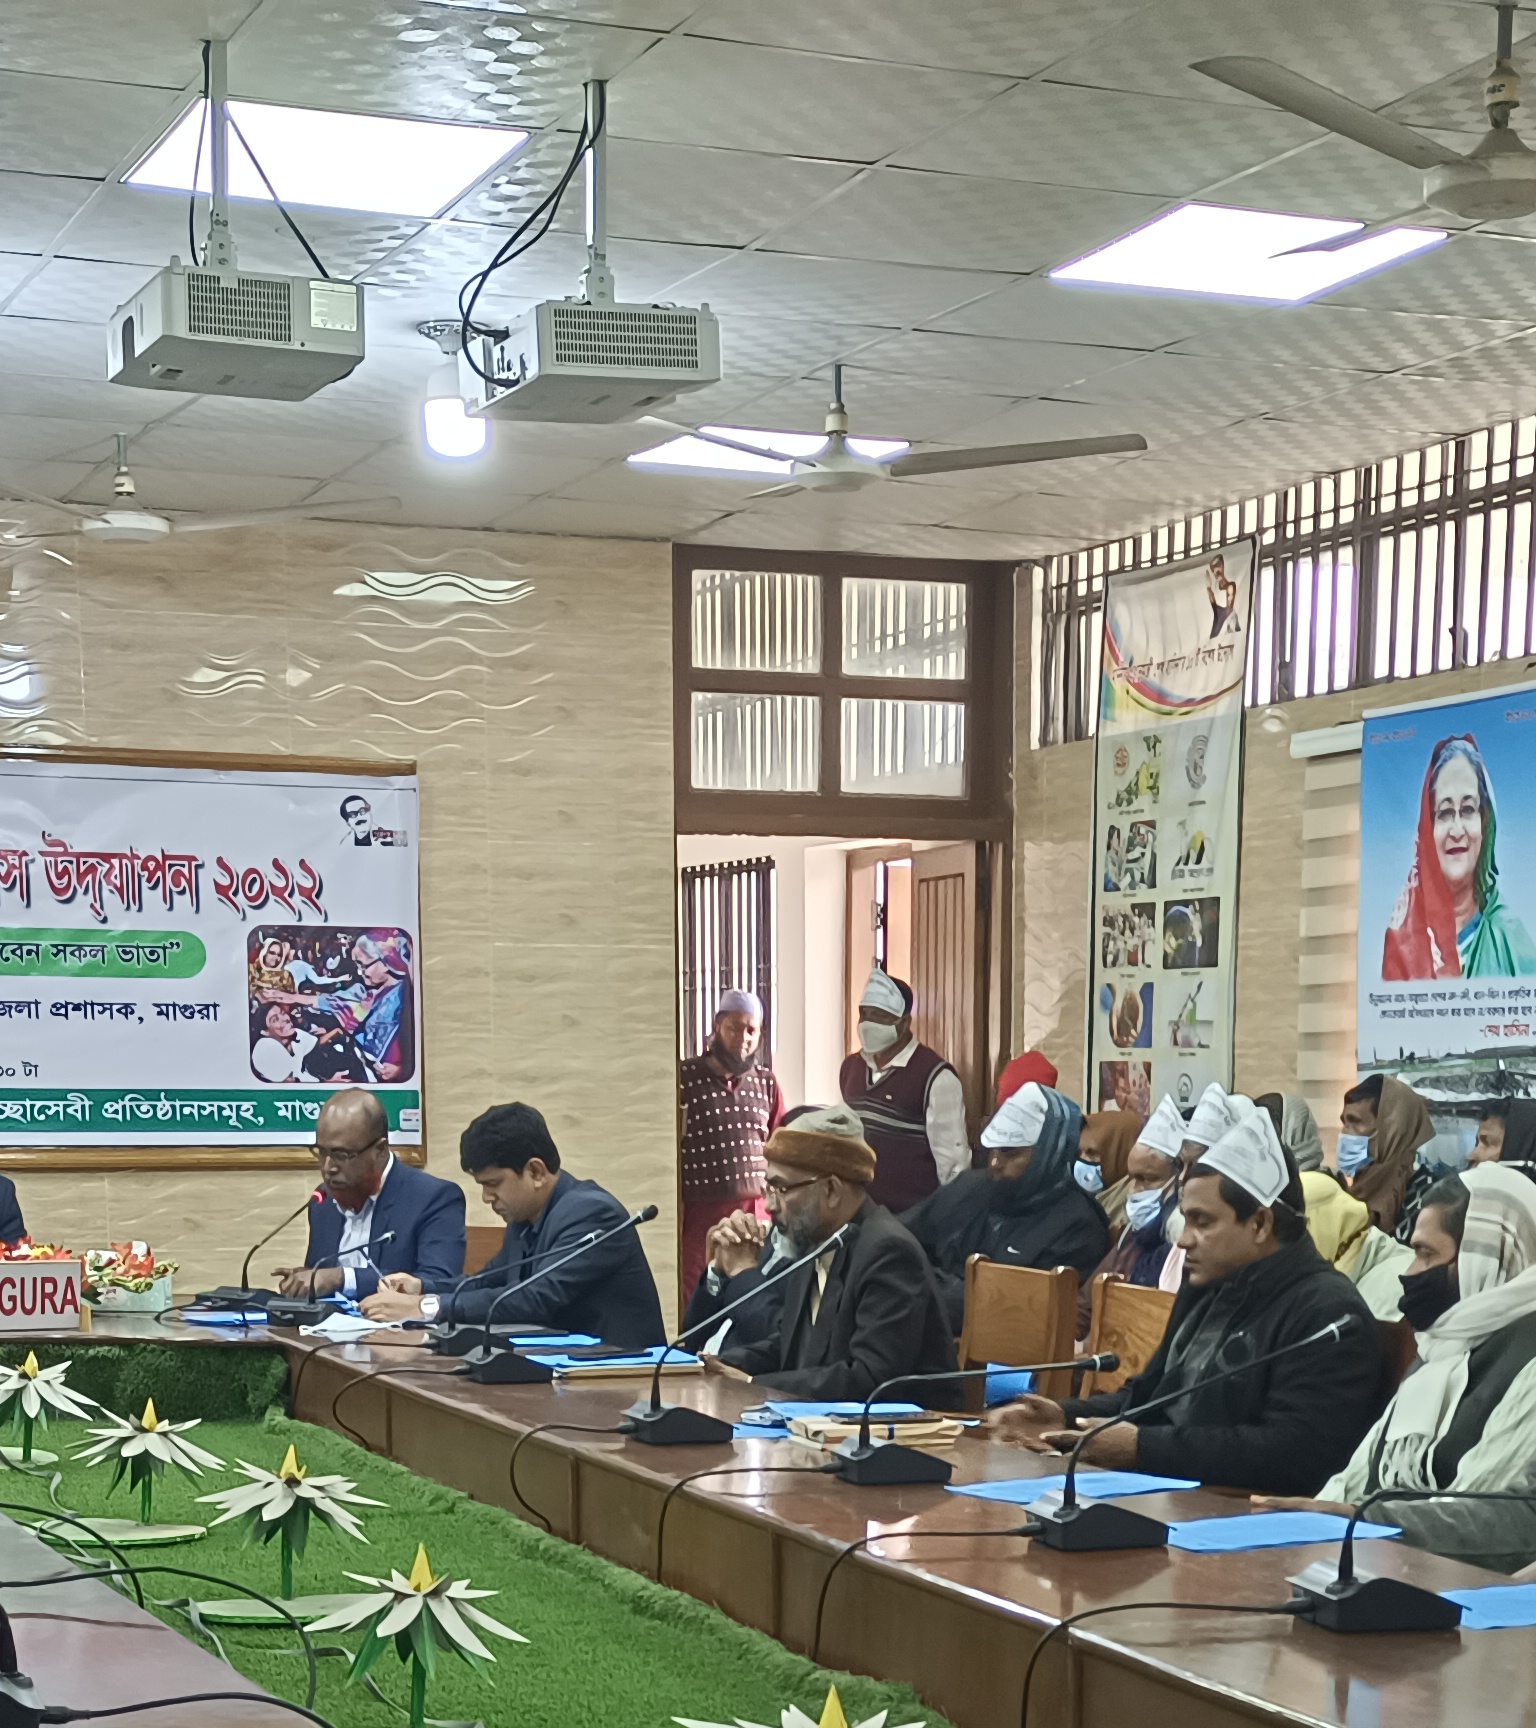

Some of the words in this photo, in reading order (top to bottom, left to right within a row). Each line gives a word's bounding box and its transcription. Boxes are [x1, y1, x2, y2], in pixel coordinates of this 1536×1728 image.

[212, 855, 326, 922] ২০২২
[50, 941, 108, 965] সকল
[49, 999, 145, 1025] প্রশাসক,
[151, 1000, 221, 1022] মাগুরা
[21, 1060, 39, 1078] টা
